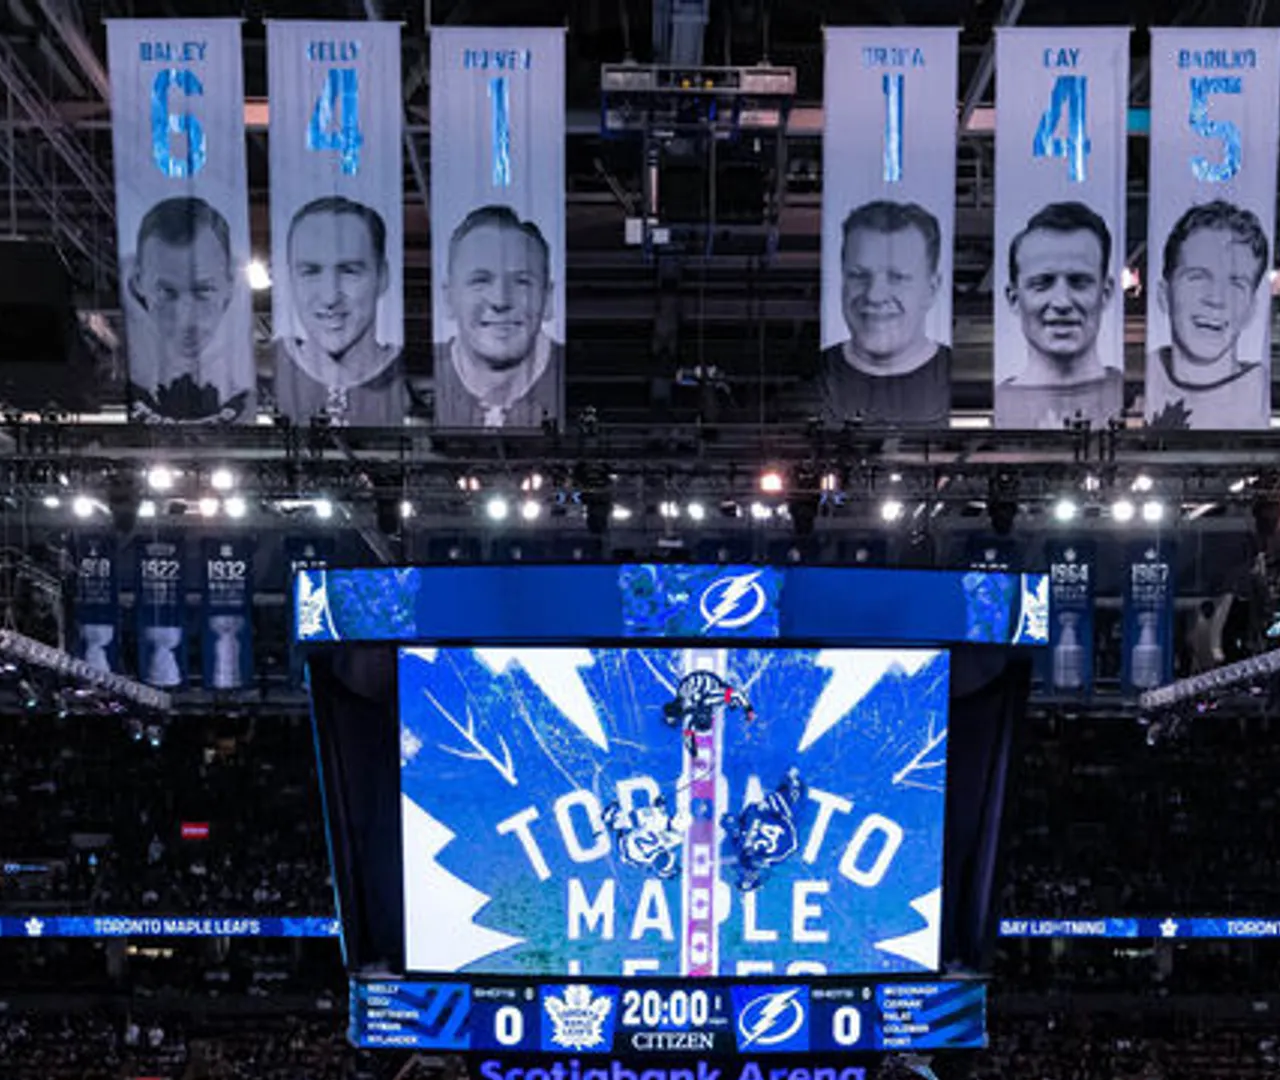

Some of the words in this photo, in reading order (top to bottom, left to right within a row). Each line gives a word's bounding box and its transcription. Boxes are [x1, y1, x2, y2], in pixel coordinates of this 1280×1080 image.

[151, 68, 206, 180] 6
[307, 68, 363, 178] 4
[488, 76, 512, 184] 1
[882, 75, 906, 184] 1
[1033, 76, 1091, 183] 4
[1190, 78, 1242, 182] 5
[207, 560, 246, 580] 1932
[94, 919, 162, 934] TORONTO
[167, 919, 212, 934] MAPLE
[216, 919, 260, 934] LEAFS
[1001, 922, 1029, 935] BAY
[495, 1005, 524, 1046] 0
[622, 989, 708, 1027] 20:00
[832, 1005, 861, 1046] 0
[631, 1031, 715, 1050] CITIZEN
